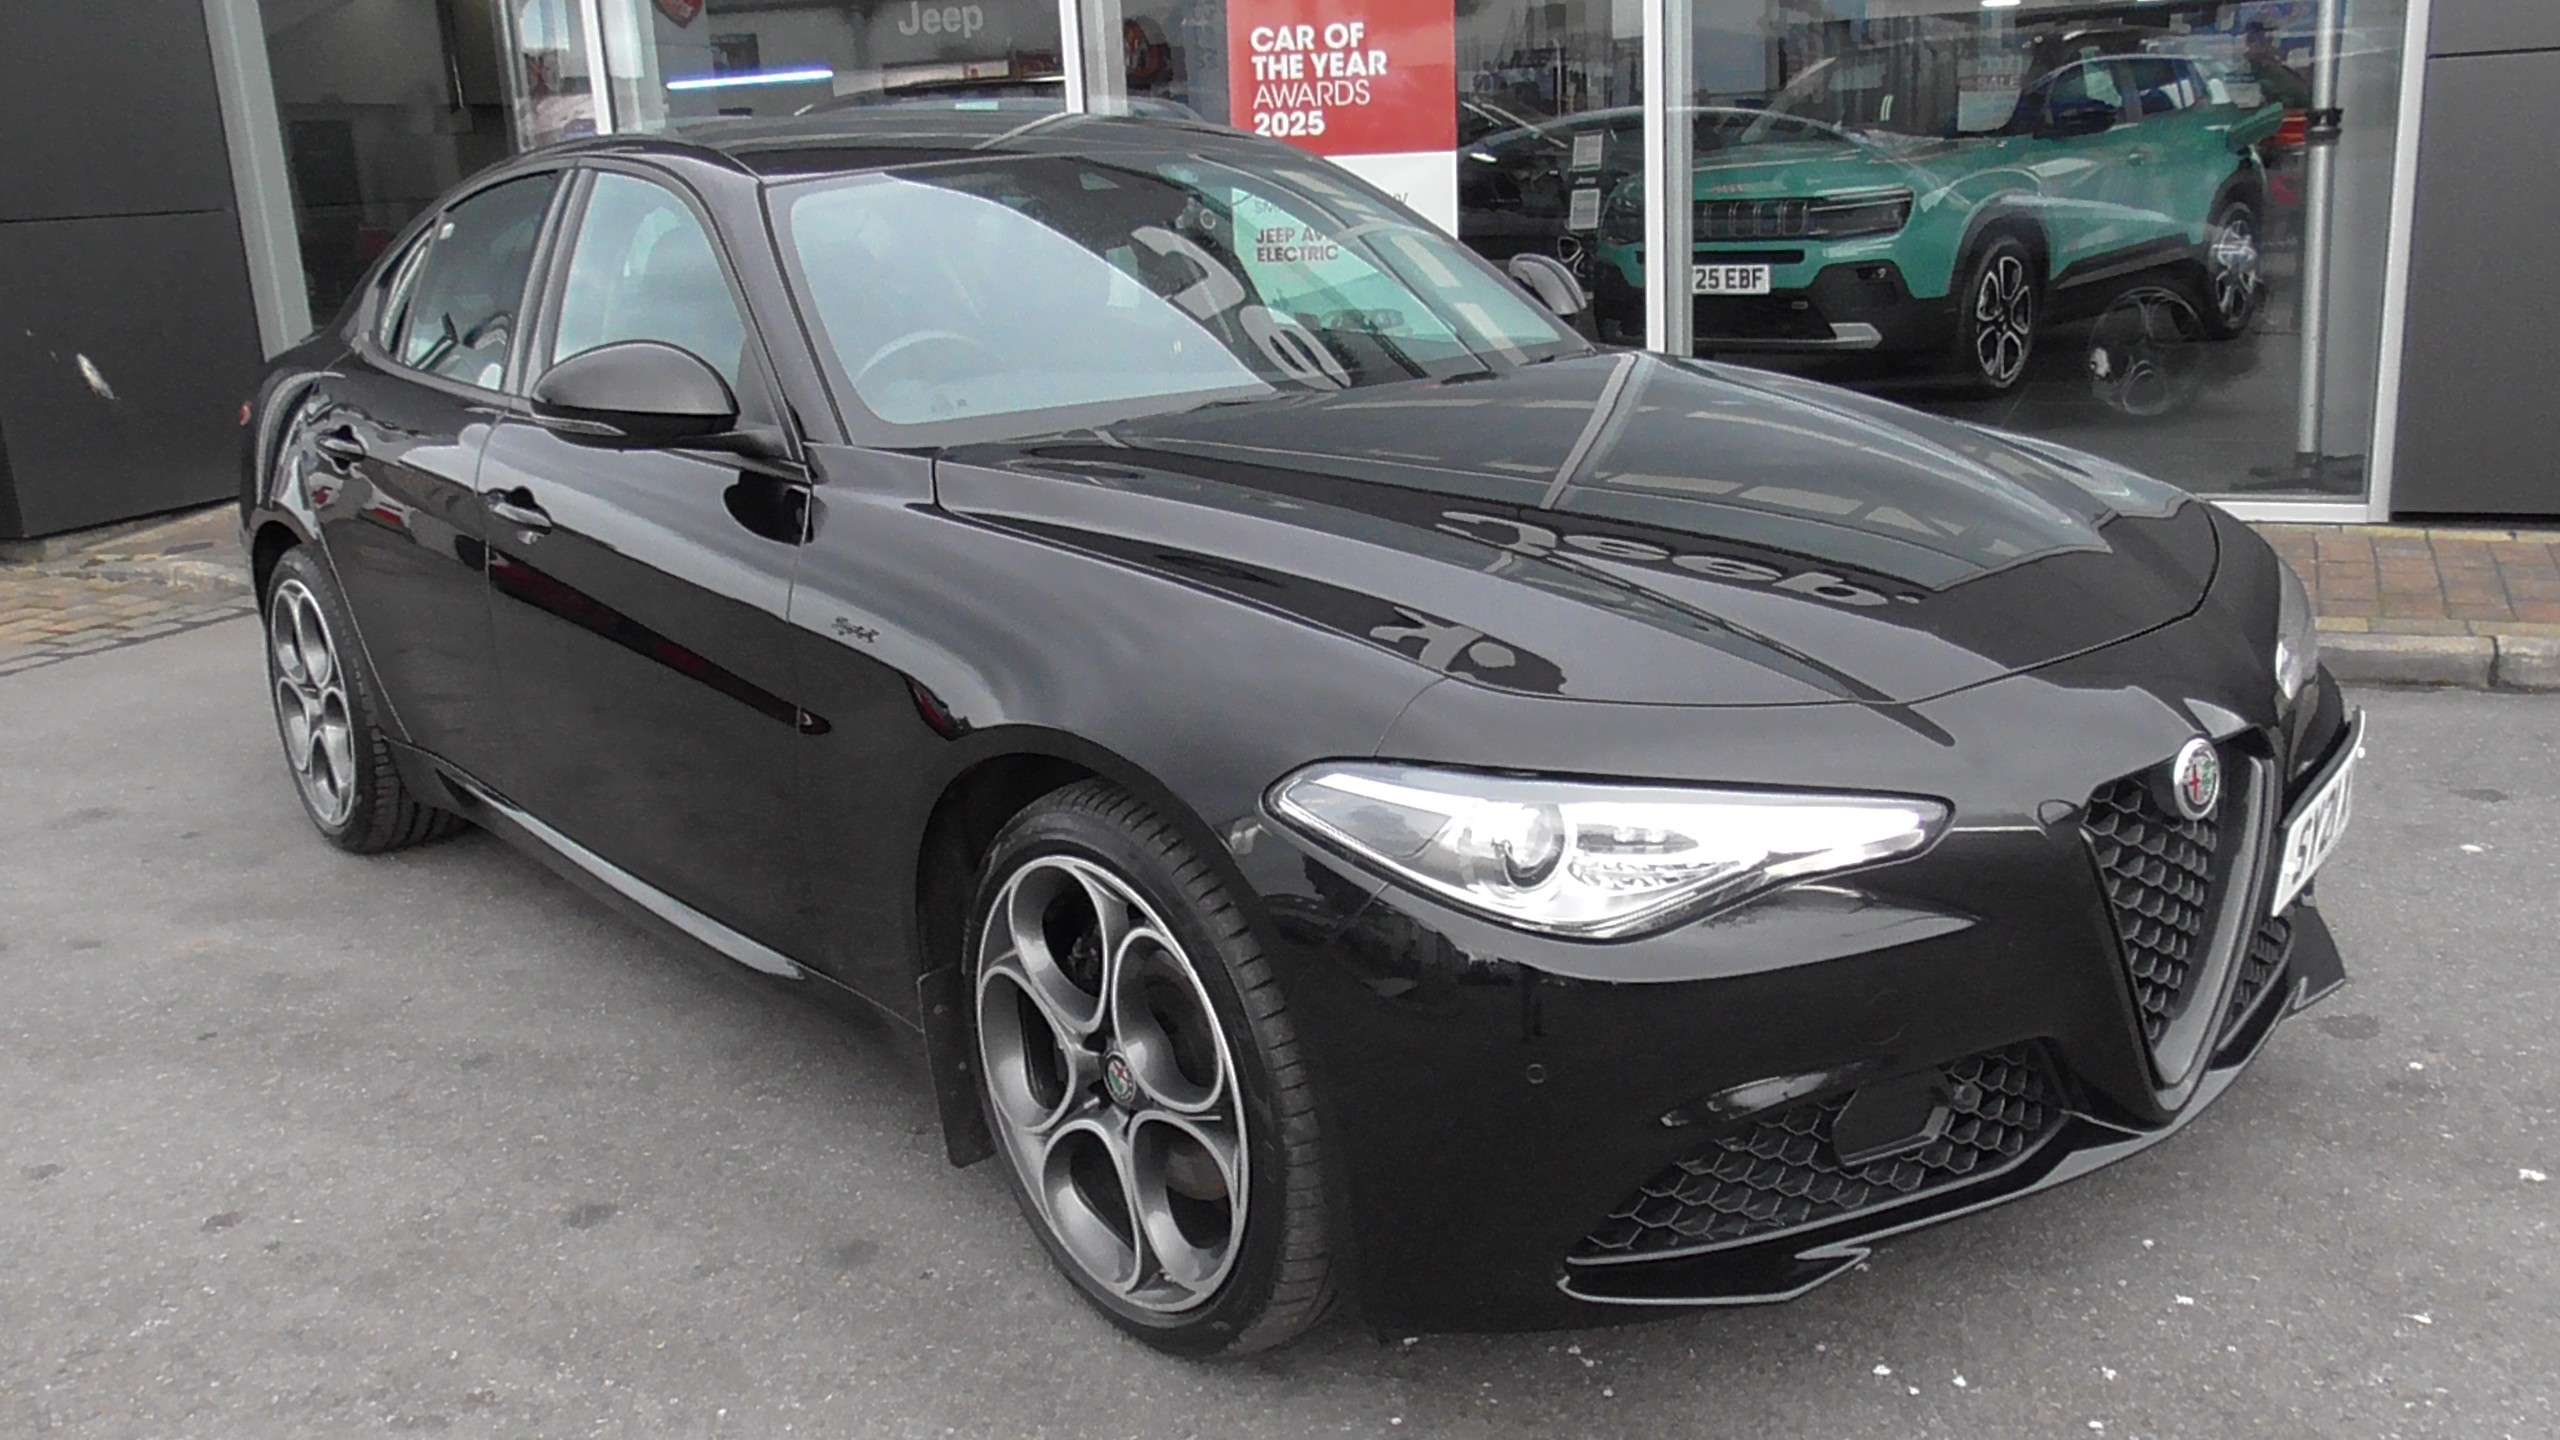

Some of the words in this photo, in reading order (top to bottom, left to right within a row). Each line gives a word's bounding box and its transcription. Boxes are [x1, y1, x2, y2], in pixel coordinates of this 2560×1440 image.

[897, 1, 984, 39] Jeep
[1250, 24, 1315, 53] CAR
[1324, 21, 1365, 49] OF
[1251, 53, 1305, 81] THE
[1310, 49, 1388, 78] YEAR
[1253, 78, 1371, 109] AWARDS
[1253, 109, 1326, 137] 2025
[1256, 229, 1295, 244] JEEP
[1257, 245, 1339, 262] ELECTRIC
[1725, 268, 1764, 289] EBF
